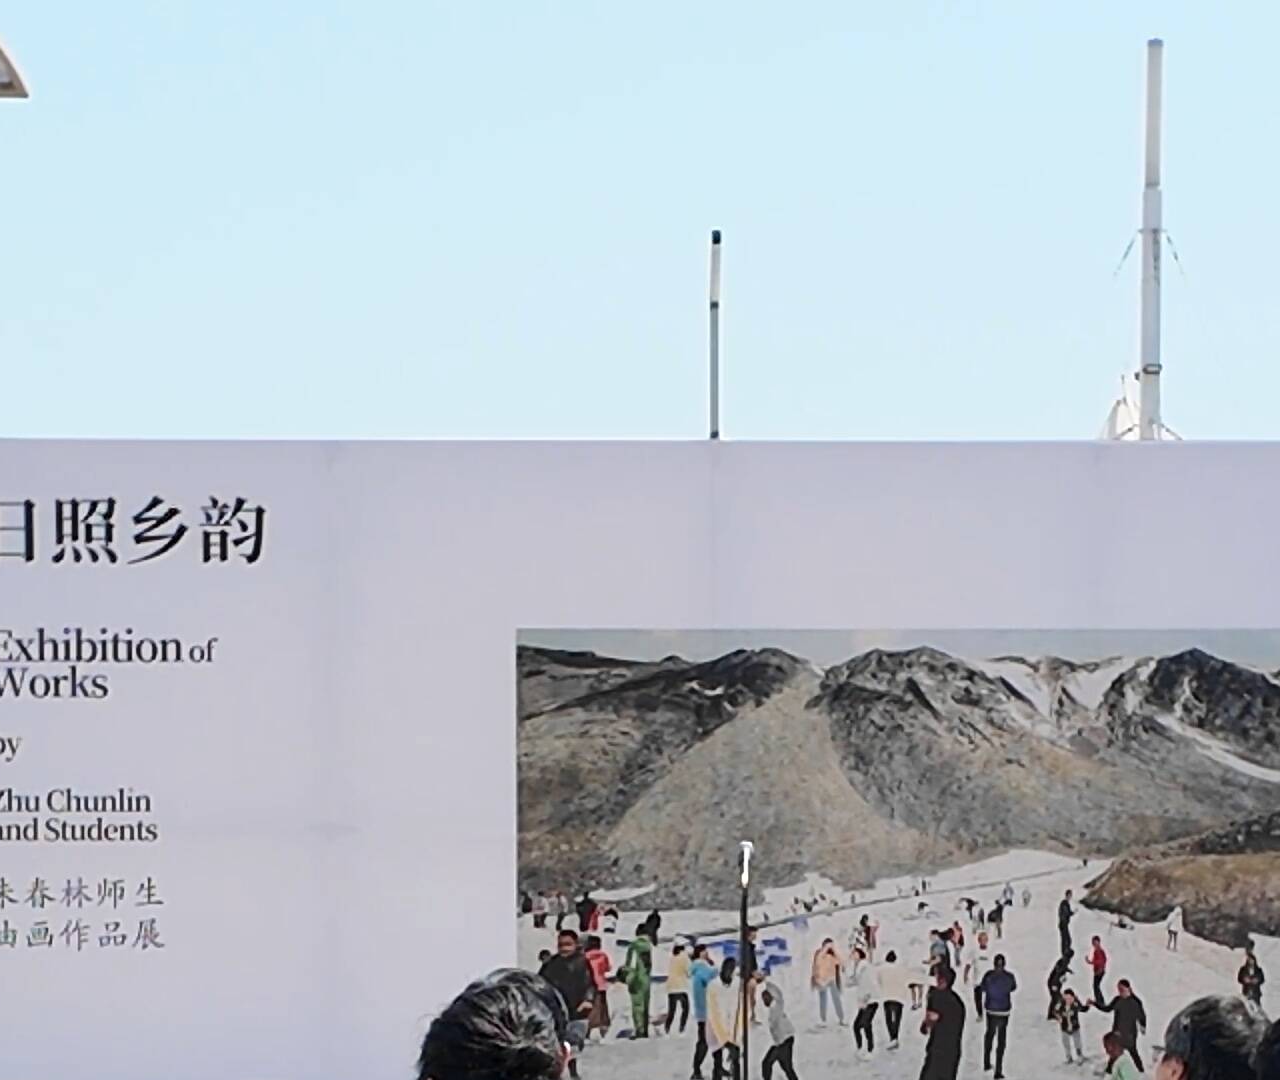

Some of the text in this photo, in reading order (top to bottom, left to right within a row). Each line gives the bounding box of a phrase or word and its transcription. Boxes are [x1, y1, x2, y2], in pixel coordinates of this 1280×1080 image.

[188, 637, 219, 664] of
[46, 787, 151, 813] Chunlin
[45, 817, 159, 843] Students
